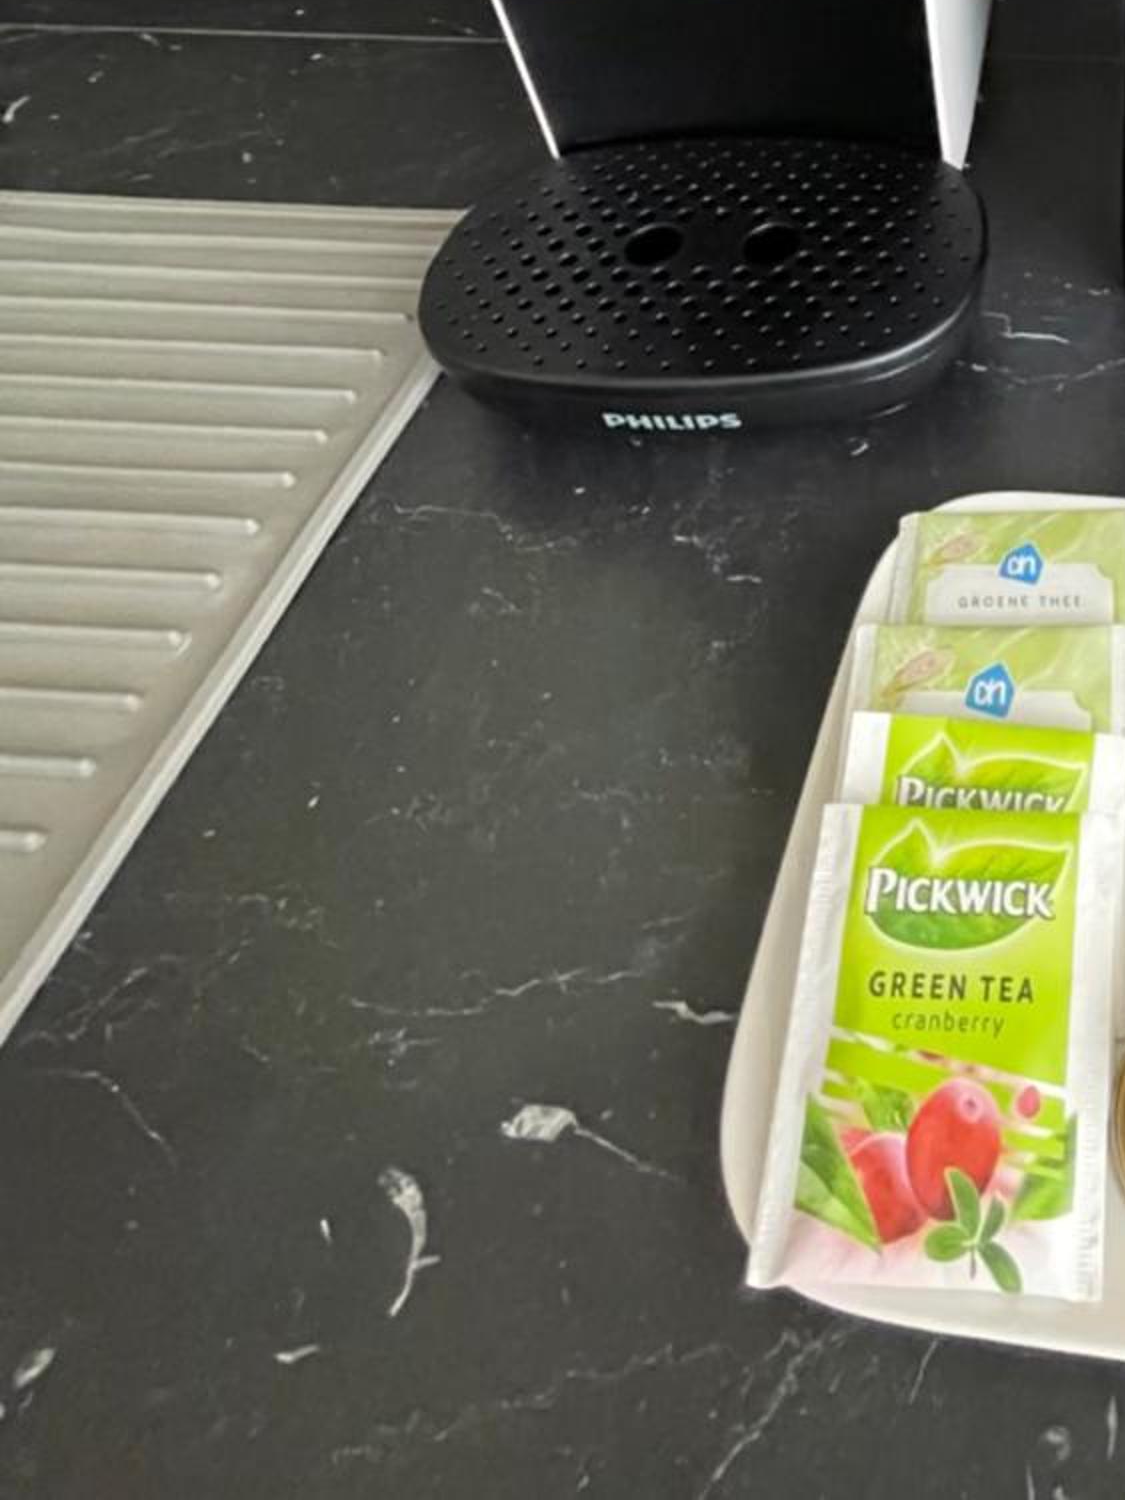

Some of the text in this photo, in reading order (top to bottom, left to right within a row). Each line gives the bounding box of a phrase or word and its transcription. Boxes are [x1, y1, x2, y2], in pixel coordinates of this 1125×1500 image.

[602, 412, 742, 431] PHILIPS
[957, 594, 1084, 609] GROENE THEE
[866, 867, 1056, 920] PICKWICK
[868, 970, 1034, 1004] GREEN TEA
[891, 1011, 1005, 1039] cranberry
